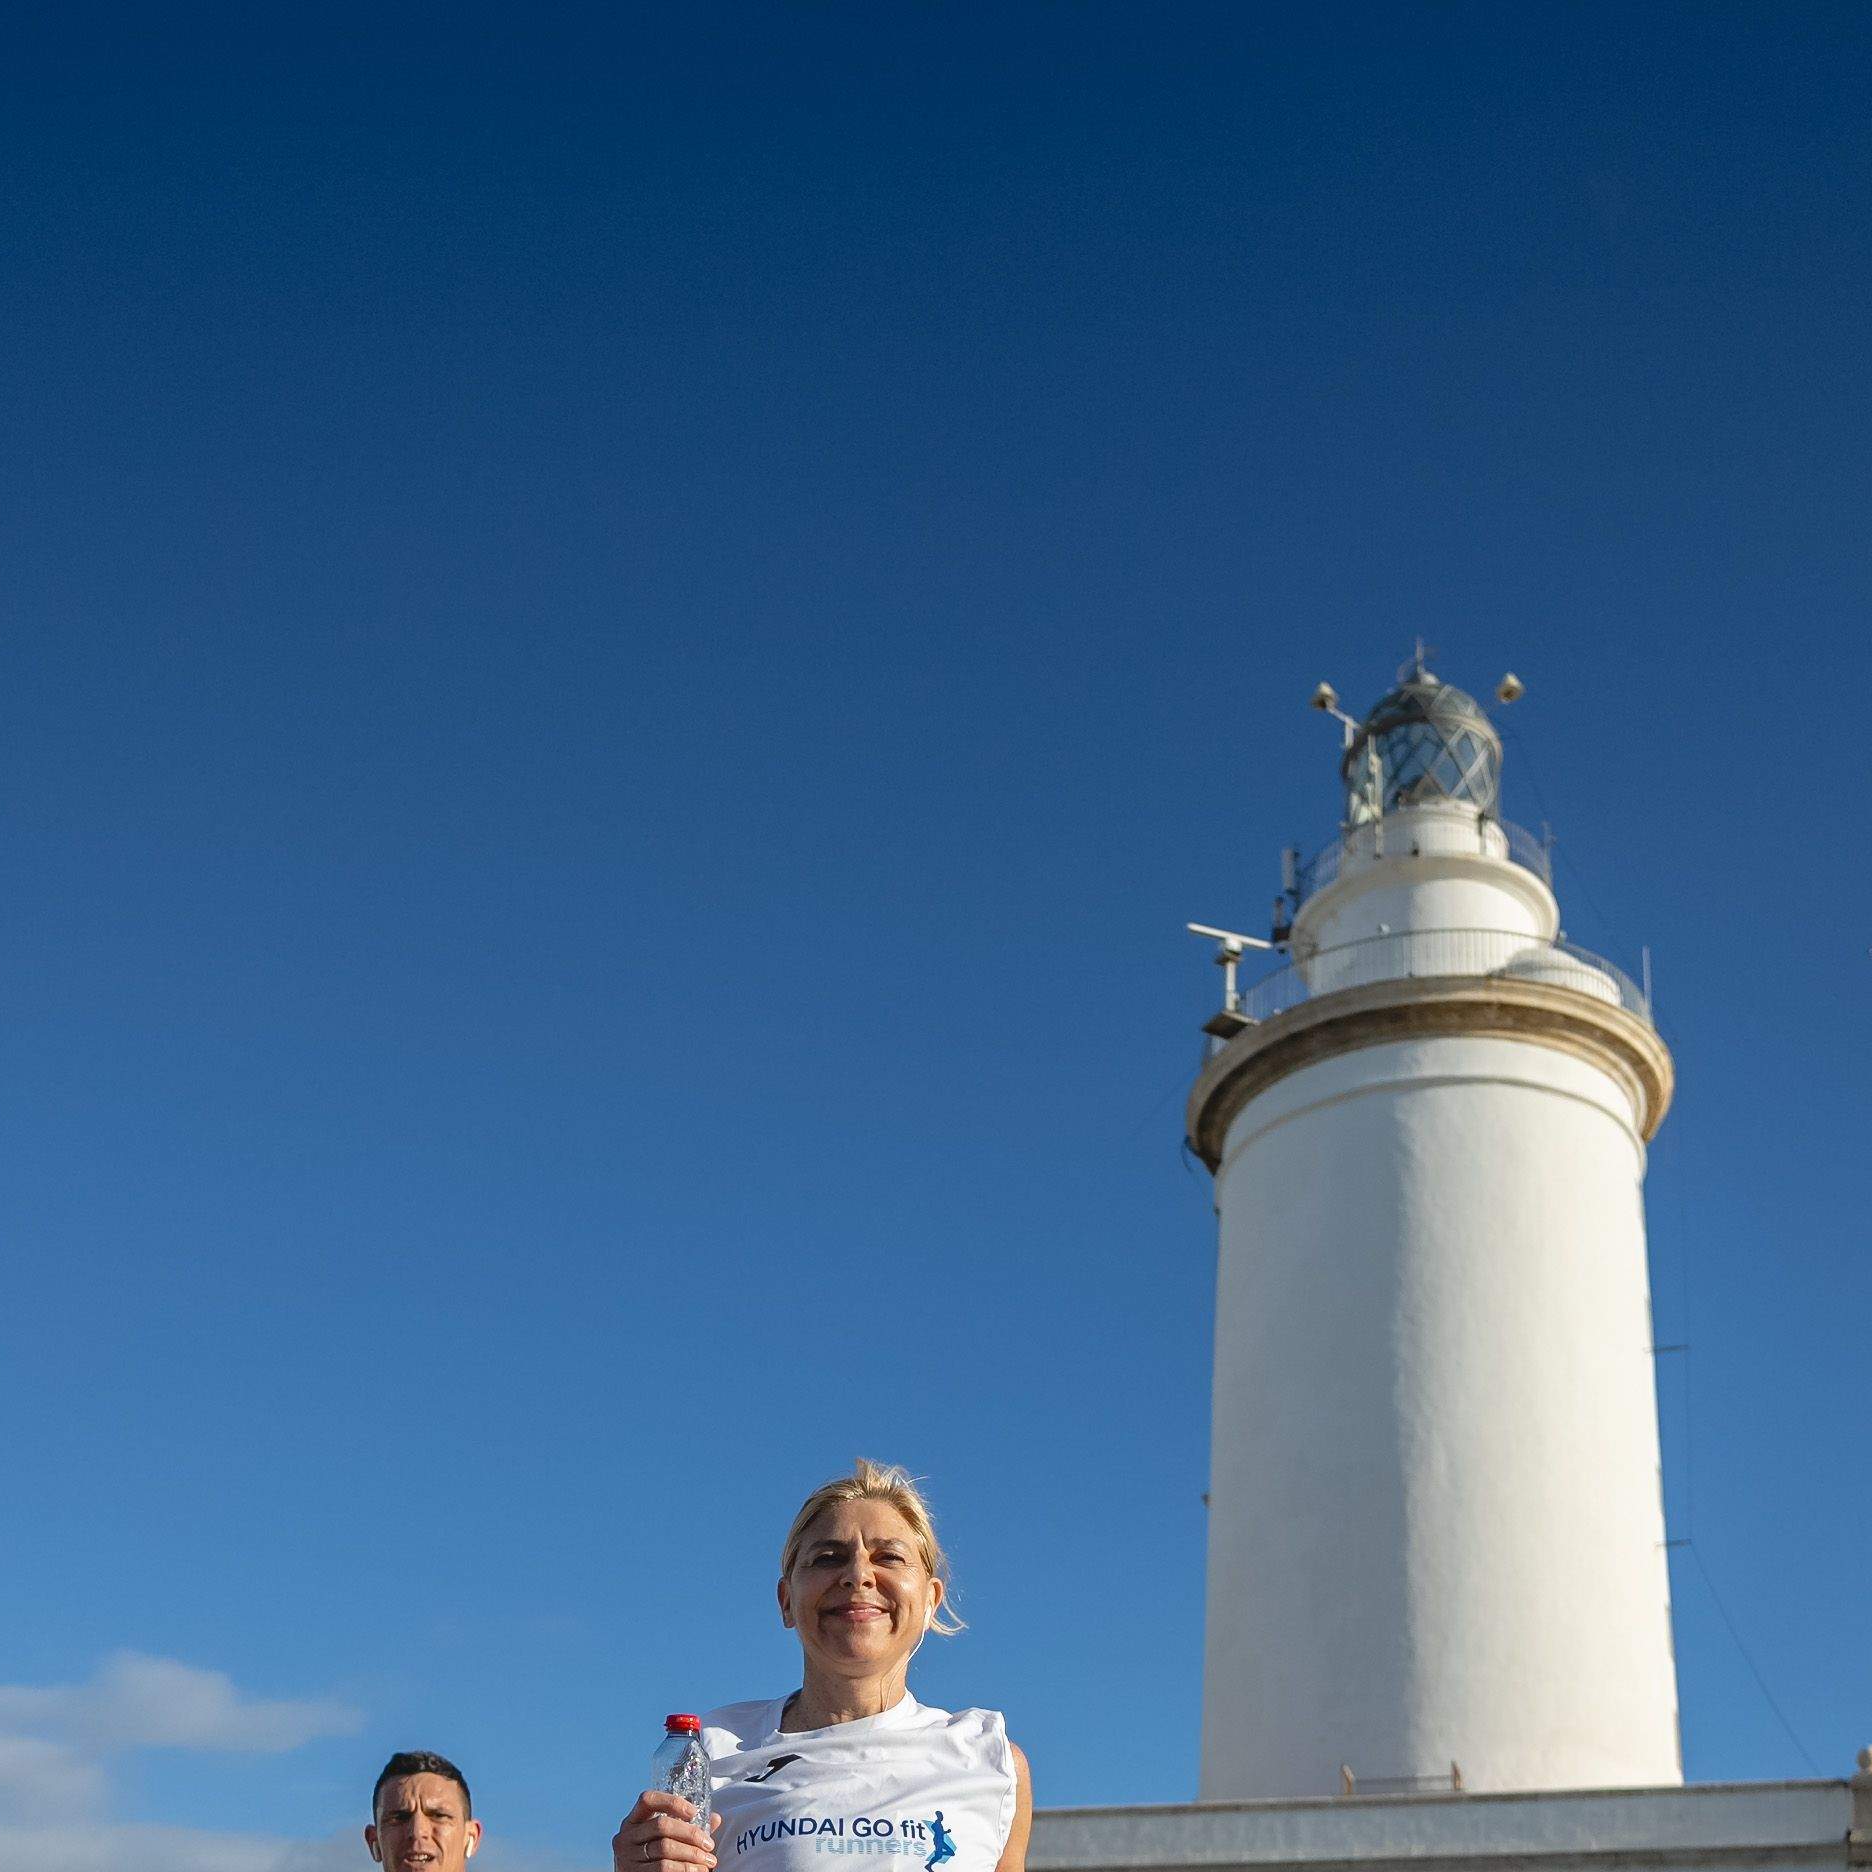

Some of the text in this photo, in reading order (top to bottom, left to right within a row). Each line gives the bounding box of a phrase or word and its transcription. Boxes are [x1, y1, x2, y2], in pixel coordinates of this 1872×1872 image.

[736, 1817, 926, 1855] HYUNDAI GO fit
[815, 1836, 927, 1857] runners
